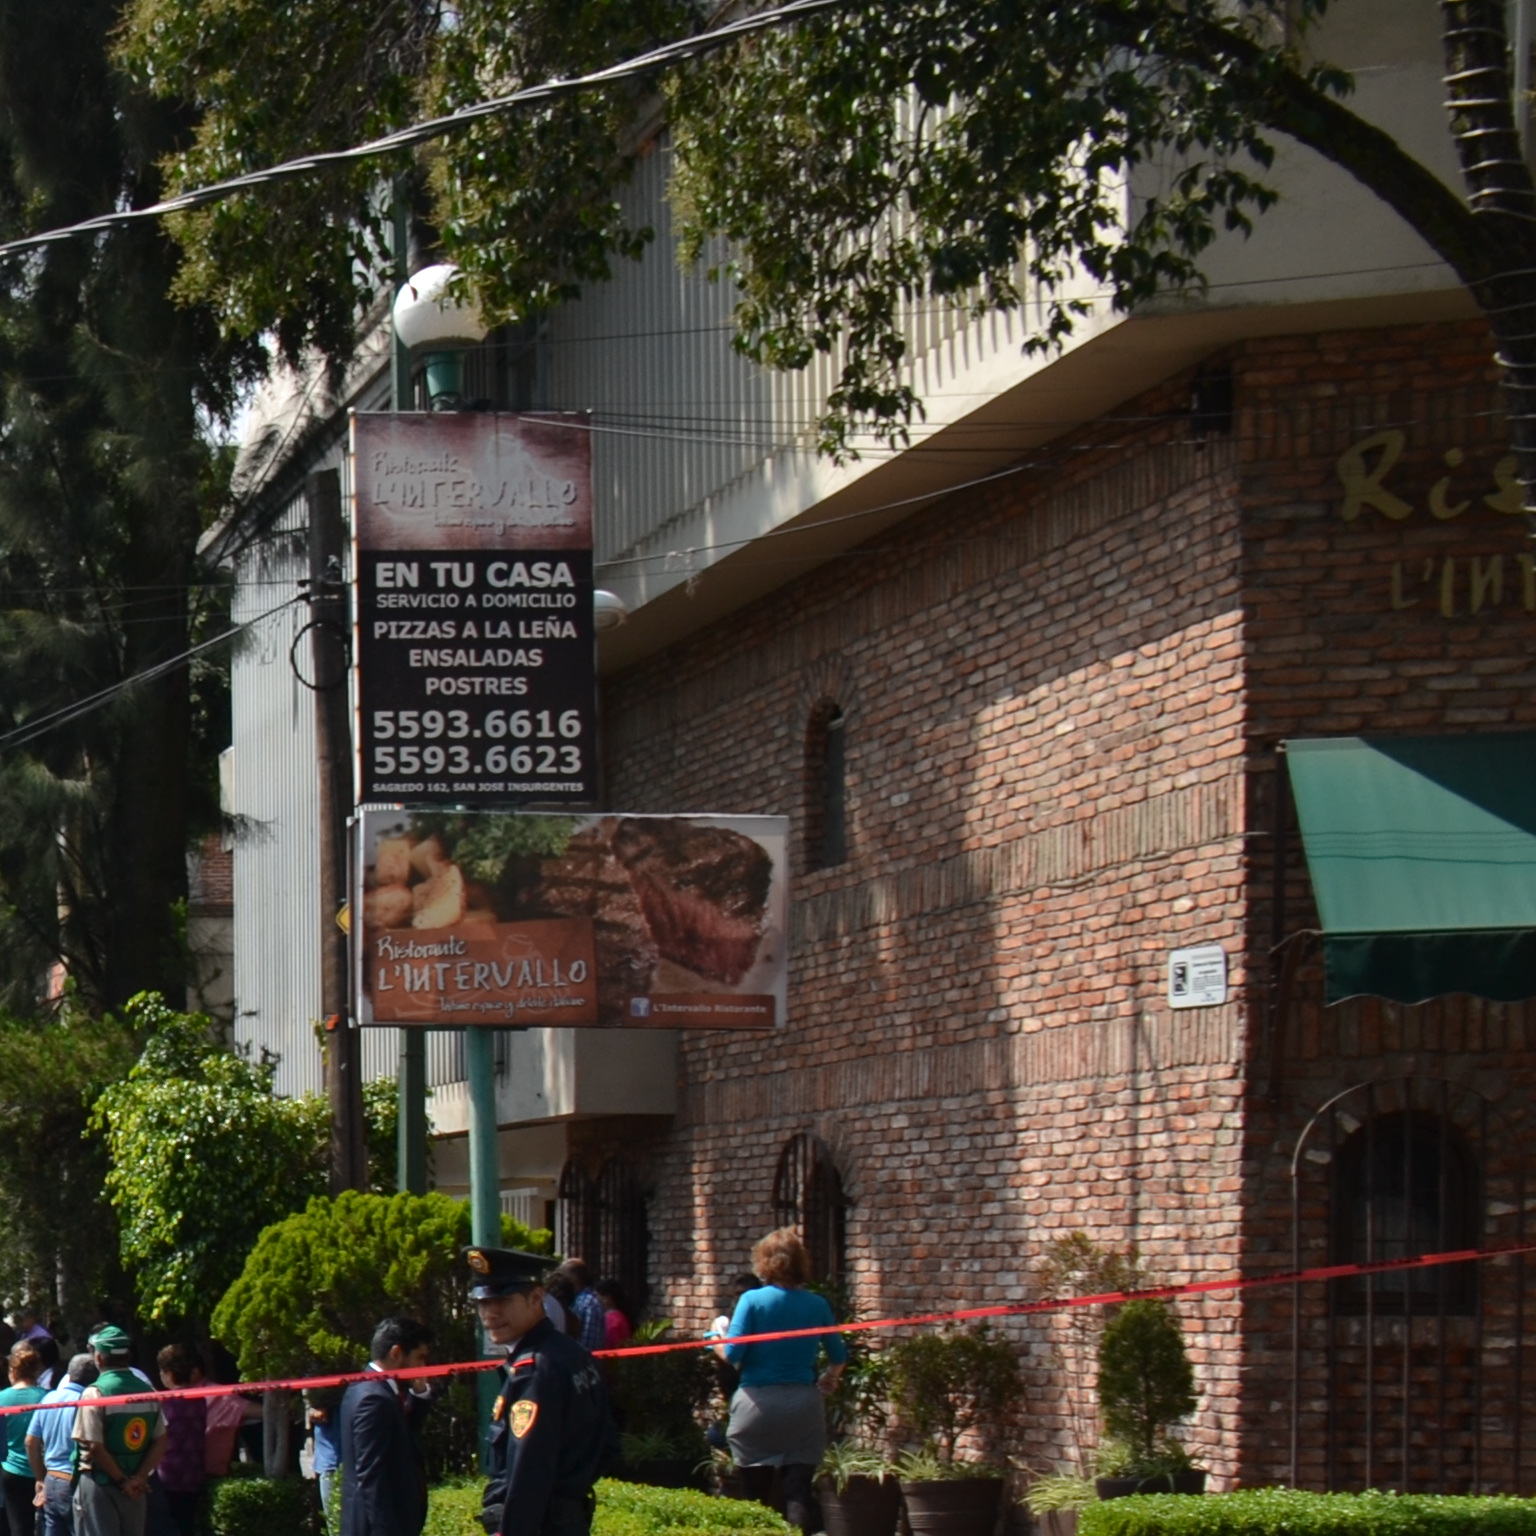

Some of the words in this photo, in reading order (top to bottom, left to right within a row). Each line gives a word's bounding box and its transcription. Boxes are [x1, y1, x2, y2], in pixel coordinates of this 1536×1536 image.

[375, 562, 419, 588] EN
[429, 562, 475, 588] TU
[486, 561, 575, 588] CASA
[376, 594, 459, 608] SERVICIO
[465, 594, 477, 608] A
[482, 593, 576, 608] DOMICILIO
[374, 621, 456, 639] PIZZAS
[462, 621, 478, 639] A
[484, 621, 512, 639] LA
[519, 616, 577, 639] LEÑA
[409, 649, 543, 667] ENSALADAS
[426, 677, 528, 695] POSTRES
[373, 710, 581, 739] 5593.6616
[374, 746, 582, 774] 5593.6623
[372, 783, 424, 793] SAGREDO
[427, 783, 450, 793] 162,
[453, 783, 475, 792] SAN
[508, 782, 584, 792] INSURGENTES
[377, 935, 466, 960] Ristorante
[378, 959, 587, 993] L'INTERVALLO
[714, 1004, 767, 1013] Ristorante
